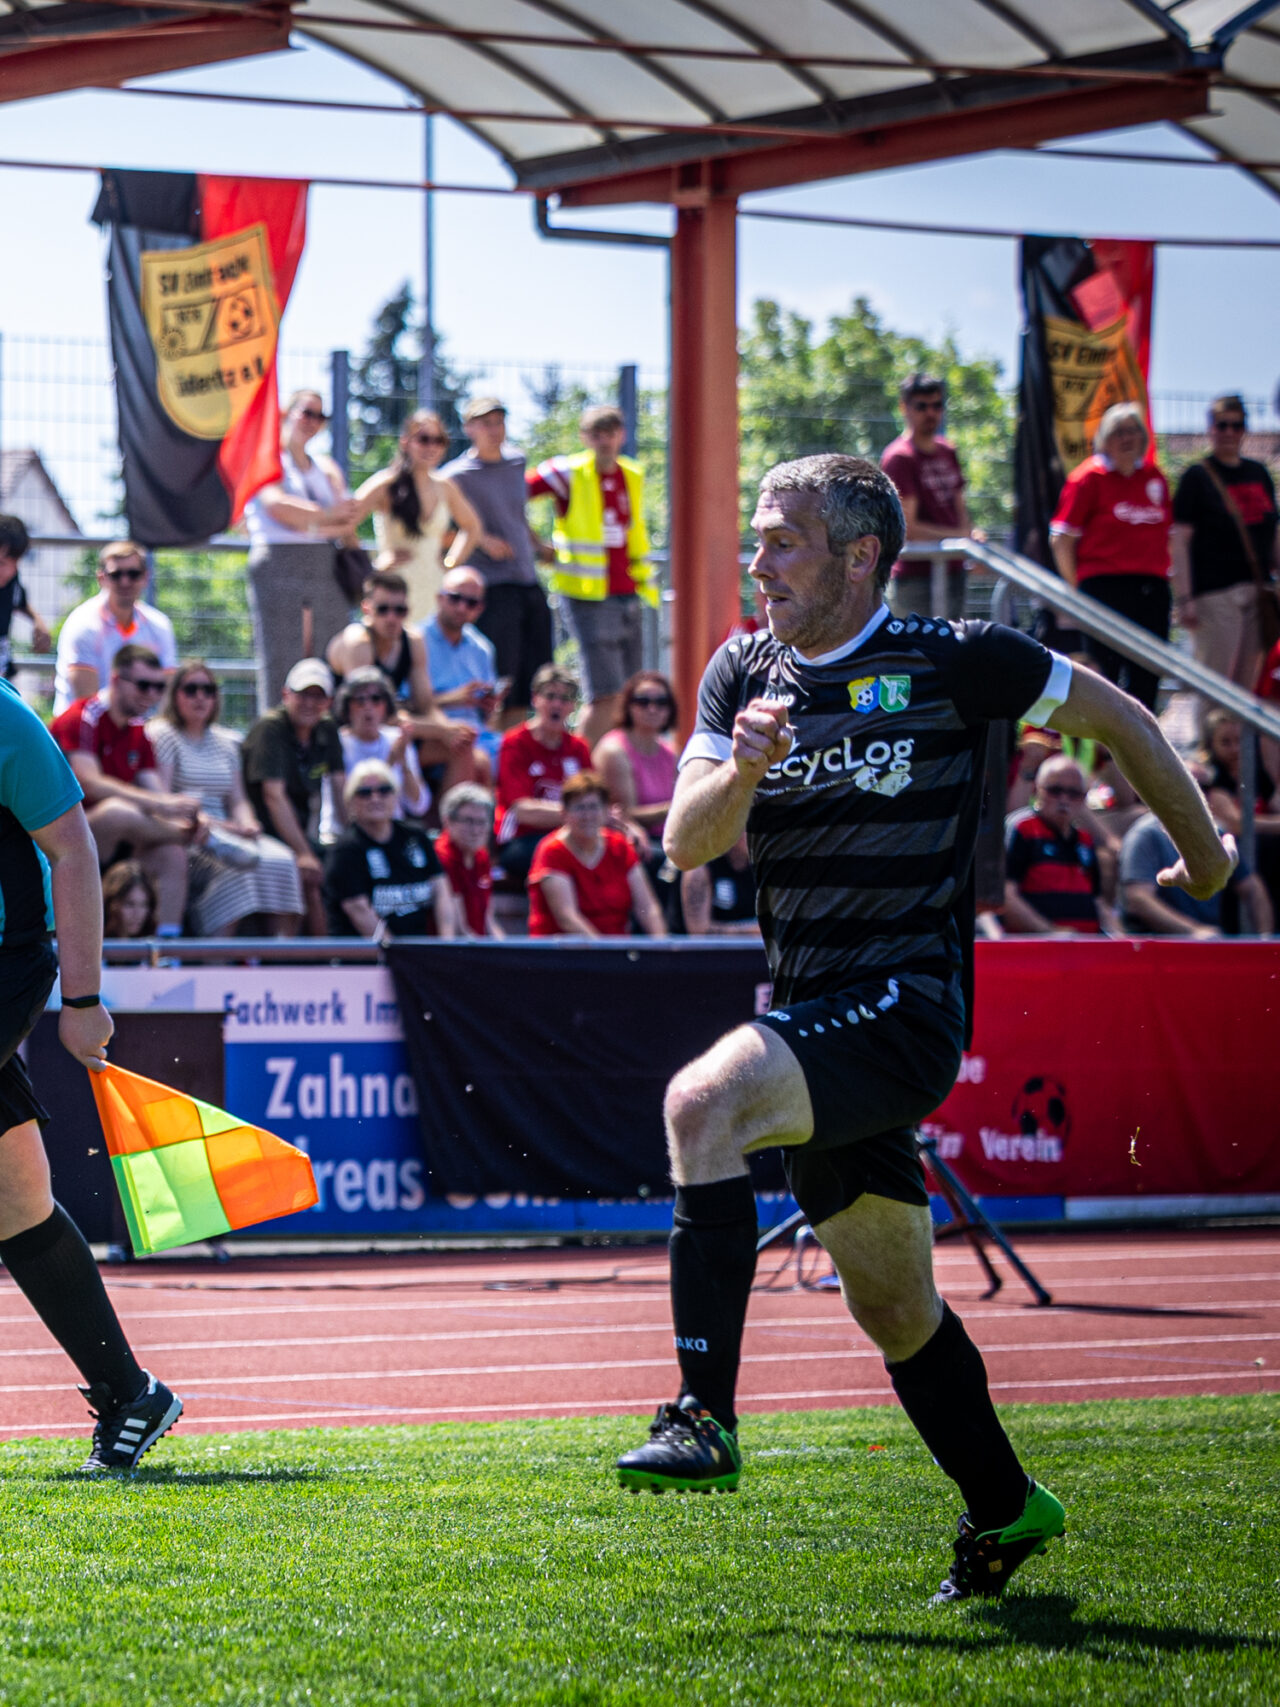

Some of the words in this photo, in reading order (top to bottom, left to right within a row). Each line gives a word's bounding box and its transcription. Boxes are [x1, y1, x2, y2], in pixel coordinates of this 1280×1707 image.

[223, 991, 346, 1026] Fachwerk
[265, 1053, 420, 1119] Zahna
[979, 1127, 1063, 1163] Verein
